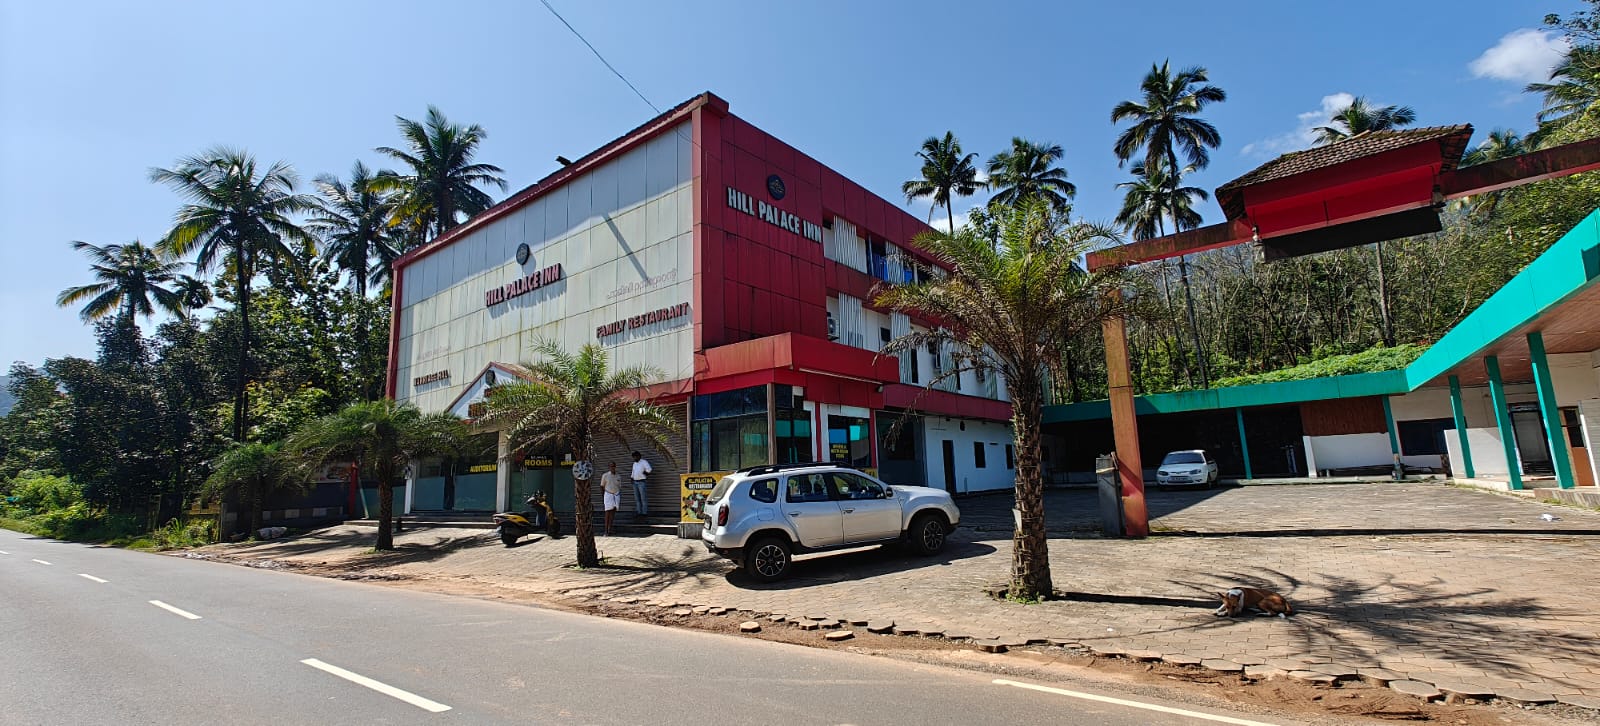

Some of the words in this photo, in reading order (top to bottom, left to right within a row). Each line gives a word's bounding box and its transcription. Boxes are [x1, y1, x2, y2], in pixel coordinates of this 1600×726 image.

[727, 186, 755, 216] HILL
[758, 199, 800, 235] PALACE
[802, 219, 823, 243] INN
[486, 286, 504, 308] HILL
[503, 271, 541, 300] PALACE
[540, 262, 562, 286] INN
[596, 319, 626, 338] FAMILY
[628, 302, 689, 330] RESTAURANT
